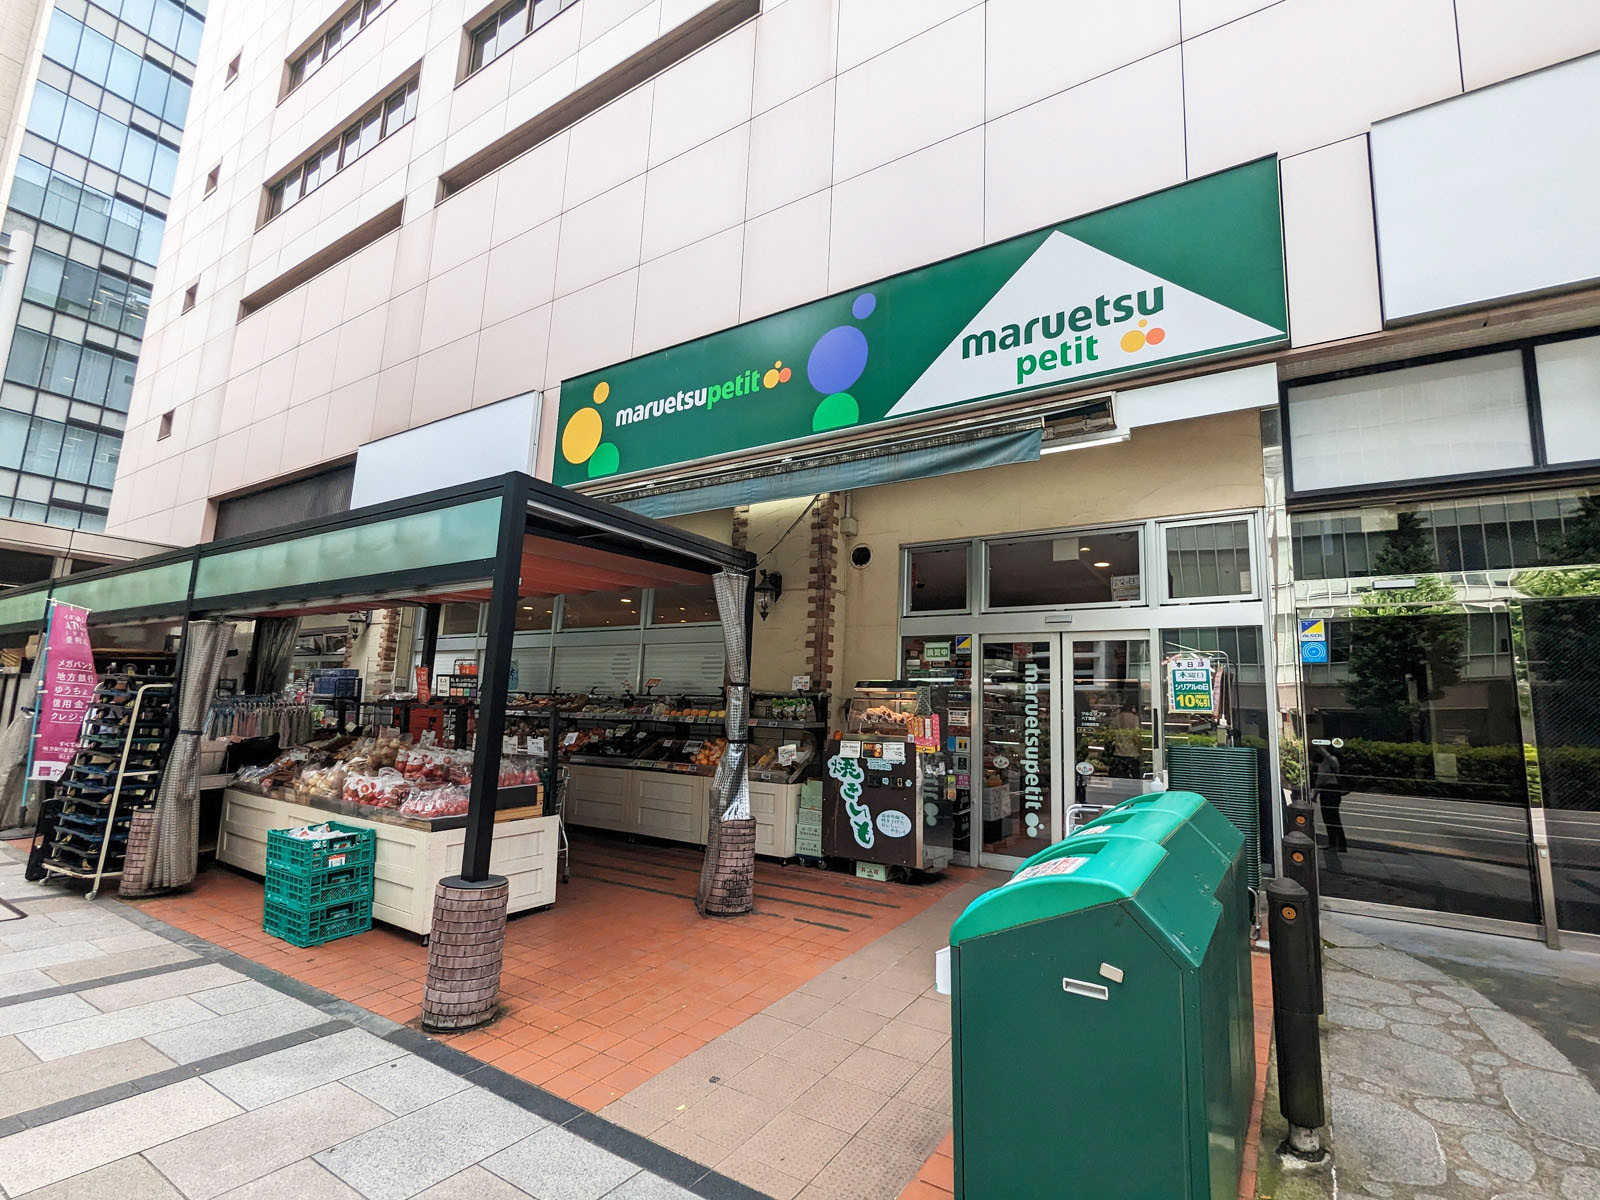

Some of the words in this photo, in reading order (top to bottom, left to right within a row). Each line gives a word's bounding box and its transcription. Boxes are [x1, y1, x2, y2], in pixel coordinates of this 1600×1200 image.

[962, 286, 1164, 360] maruetsu
[1017, 335, 1099, 385] petit
[52, 698, 88, 709] 信用金
[1020, 663, 1044, 810] maruetsupetit
